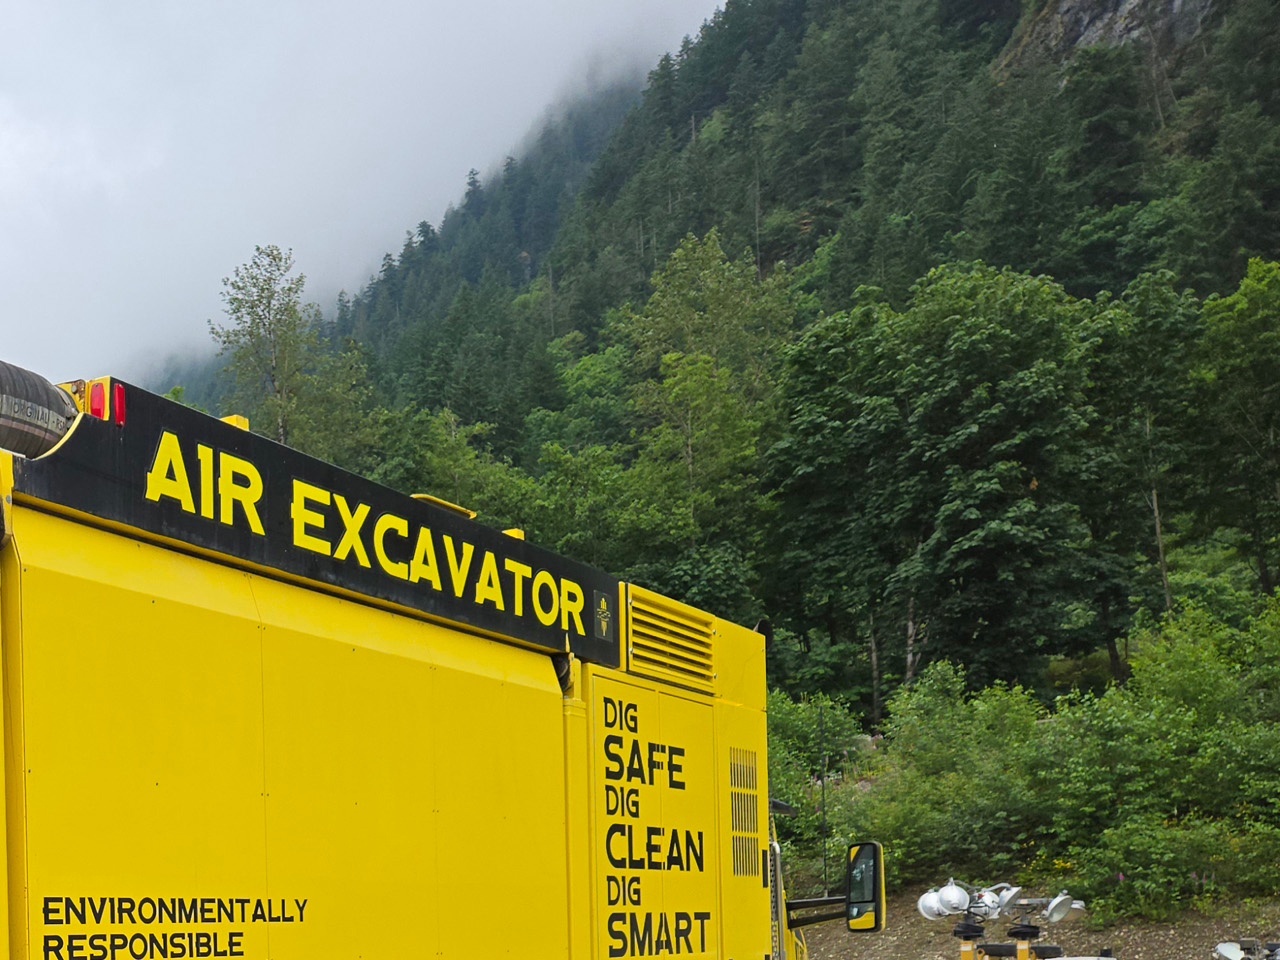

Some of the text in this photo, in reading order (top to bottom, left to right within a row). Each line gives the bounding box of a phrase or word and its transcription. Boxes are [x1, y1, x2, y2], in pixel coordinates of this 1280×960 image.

[145, 430, 587, 637] AIR EXCAVATOR
[603, 696, 638, 734] DIG
[604, 734, 686, 790] SAFE
[605, 784, 640, 818] DIG
[606, 823, 704, 873] CLEAN
[42, 896, 309, 926] ENVIRONMENTALLY
[607, 875, 641, 907] DIG
[608, 912, 711, 959] SMART
